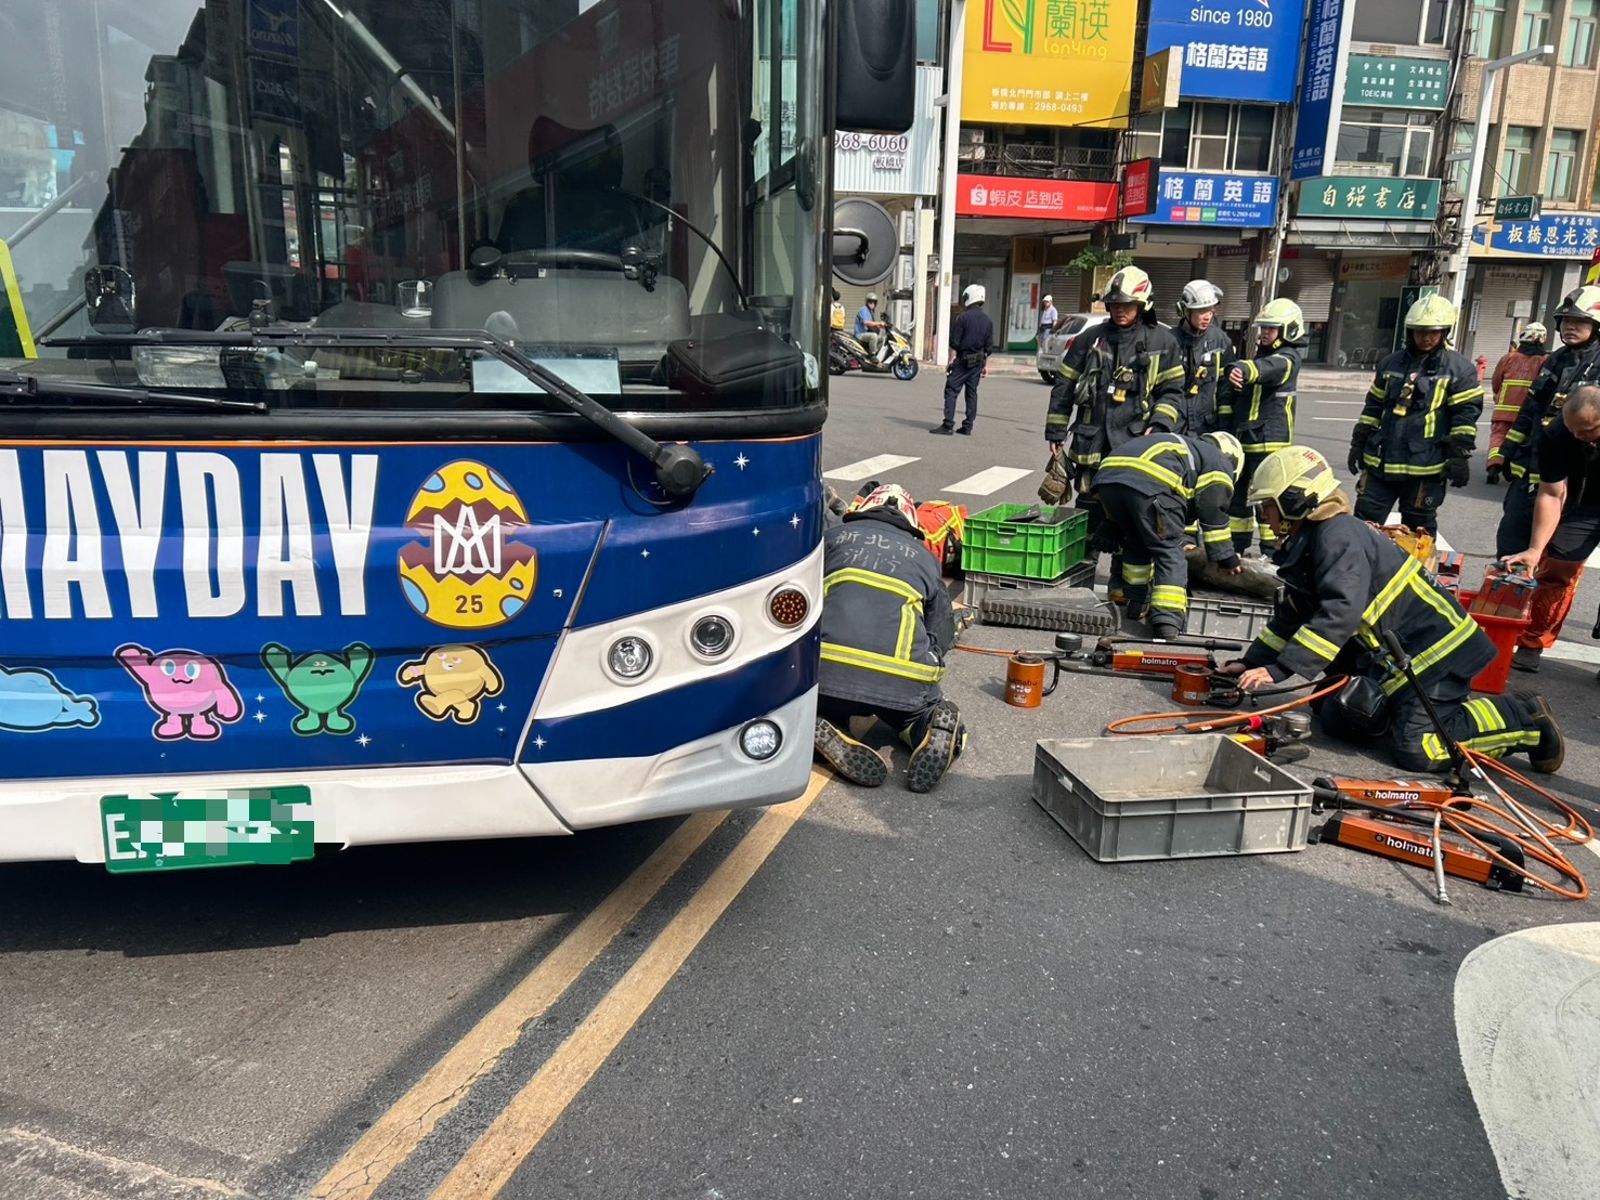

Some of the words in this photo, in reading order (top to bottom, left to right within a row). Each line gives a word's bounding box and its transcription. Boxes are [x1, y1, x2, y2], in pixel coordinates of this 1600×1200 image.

[1191, 5, 1231, 25] since
[1236, 9, 1273, 28] 1980
[1186, 41, 1269, 72] 格蘭英語
[989, 189, 1022, 208] 蝦皮
[1164, 177, 1272, 203] 格蘭英語
[455, 595, 483, 613] 25
[1141, 657, 1178, 666] holmatro
[1375, 791, 1419, 800] holmatro
